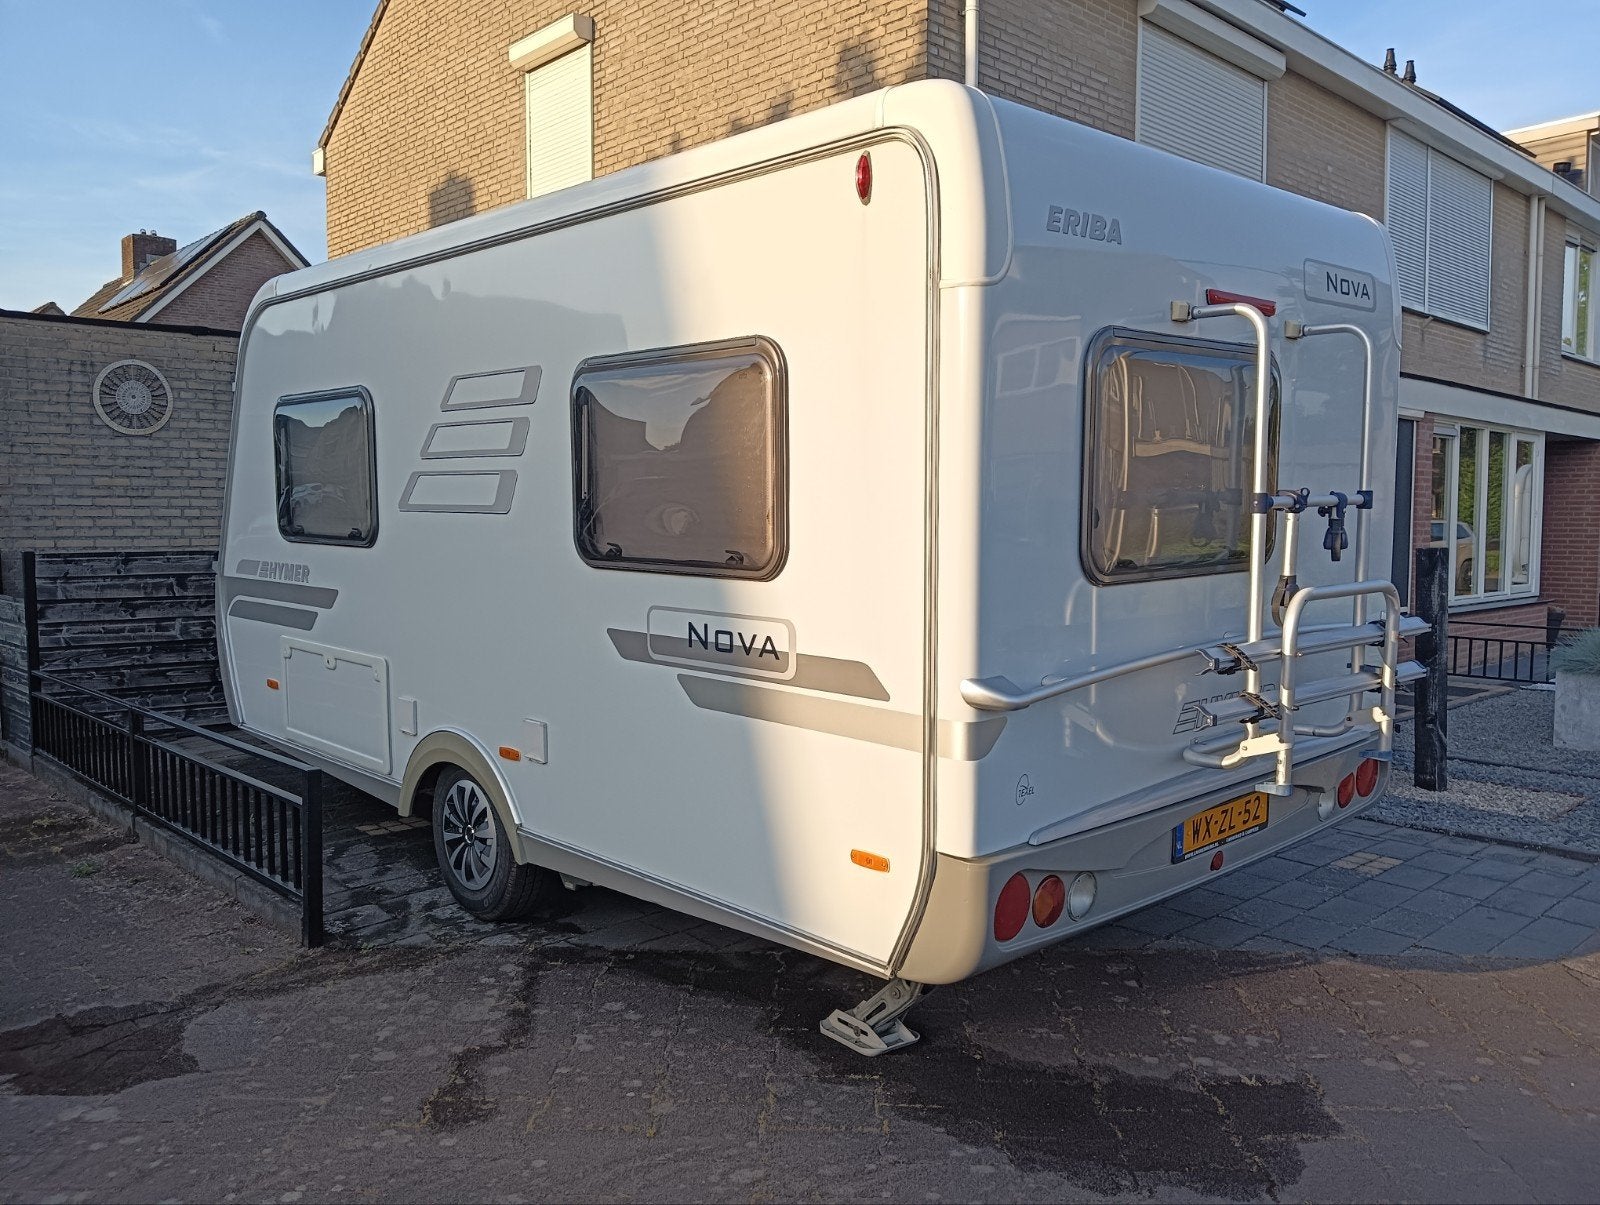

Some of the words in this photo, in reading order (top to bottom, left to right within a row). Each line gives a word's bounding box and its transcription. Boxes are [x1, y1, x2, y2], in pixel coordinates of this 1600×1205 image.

[1046, 204, 1122, 245] ERIBA
[268, 561, 310, 583] HYMER
[1192, 796, 1261, 845] WX-ZL-52
